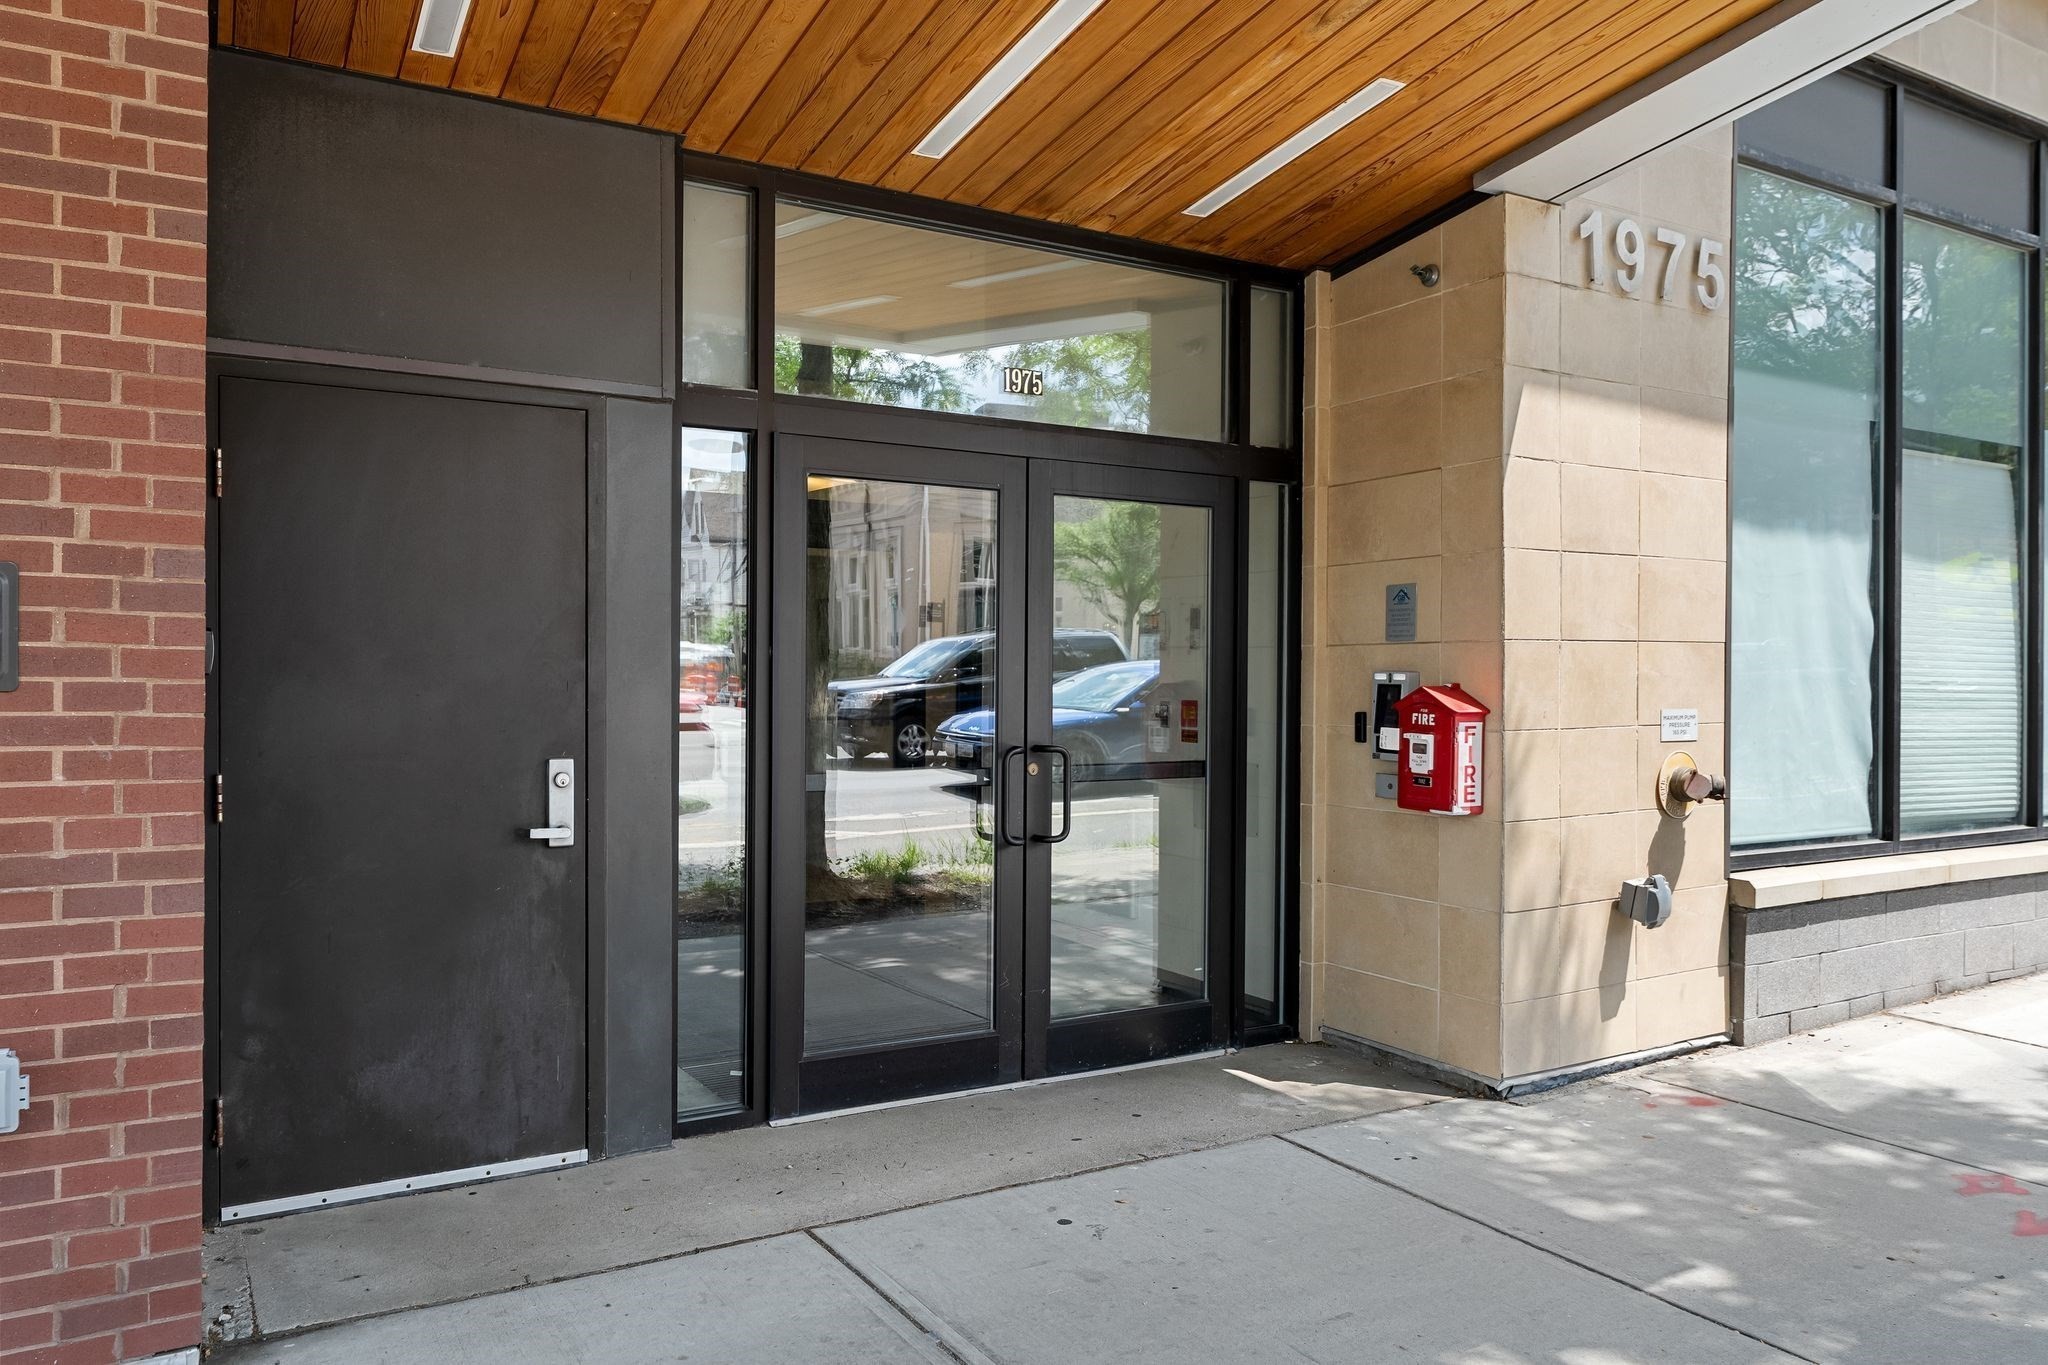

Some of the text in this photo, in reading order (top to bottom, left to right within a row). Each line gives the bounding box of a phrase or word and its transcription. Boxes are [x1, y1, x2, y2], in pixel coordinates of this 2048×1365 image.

[1580, 209, 1725, 310] 1975
[1004, 368, 1042, 395] 1975
[1412, 712, 1435, 726] FIRE
[1464, 726, 1476, 803] FIRE
